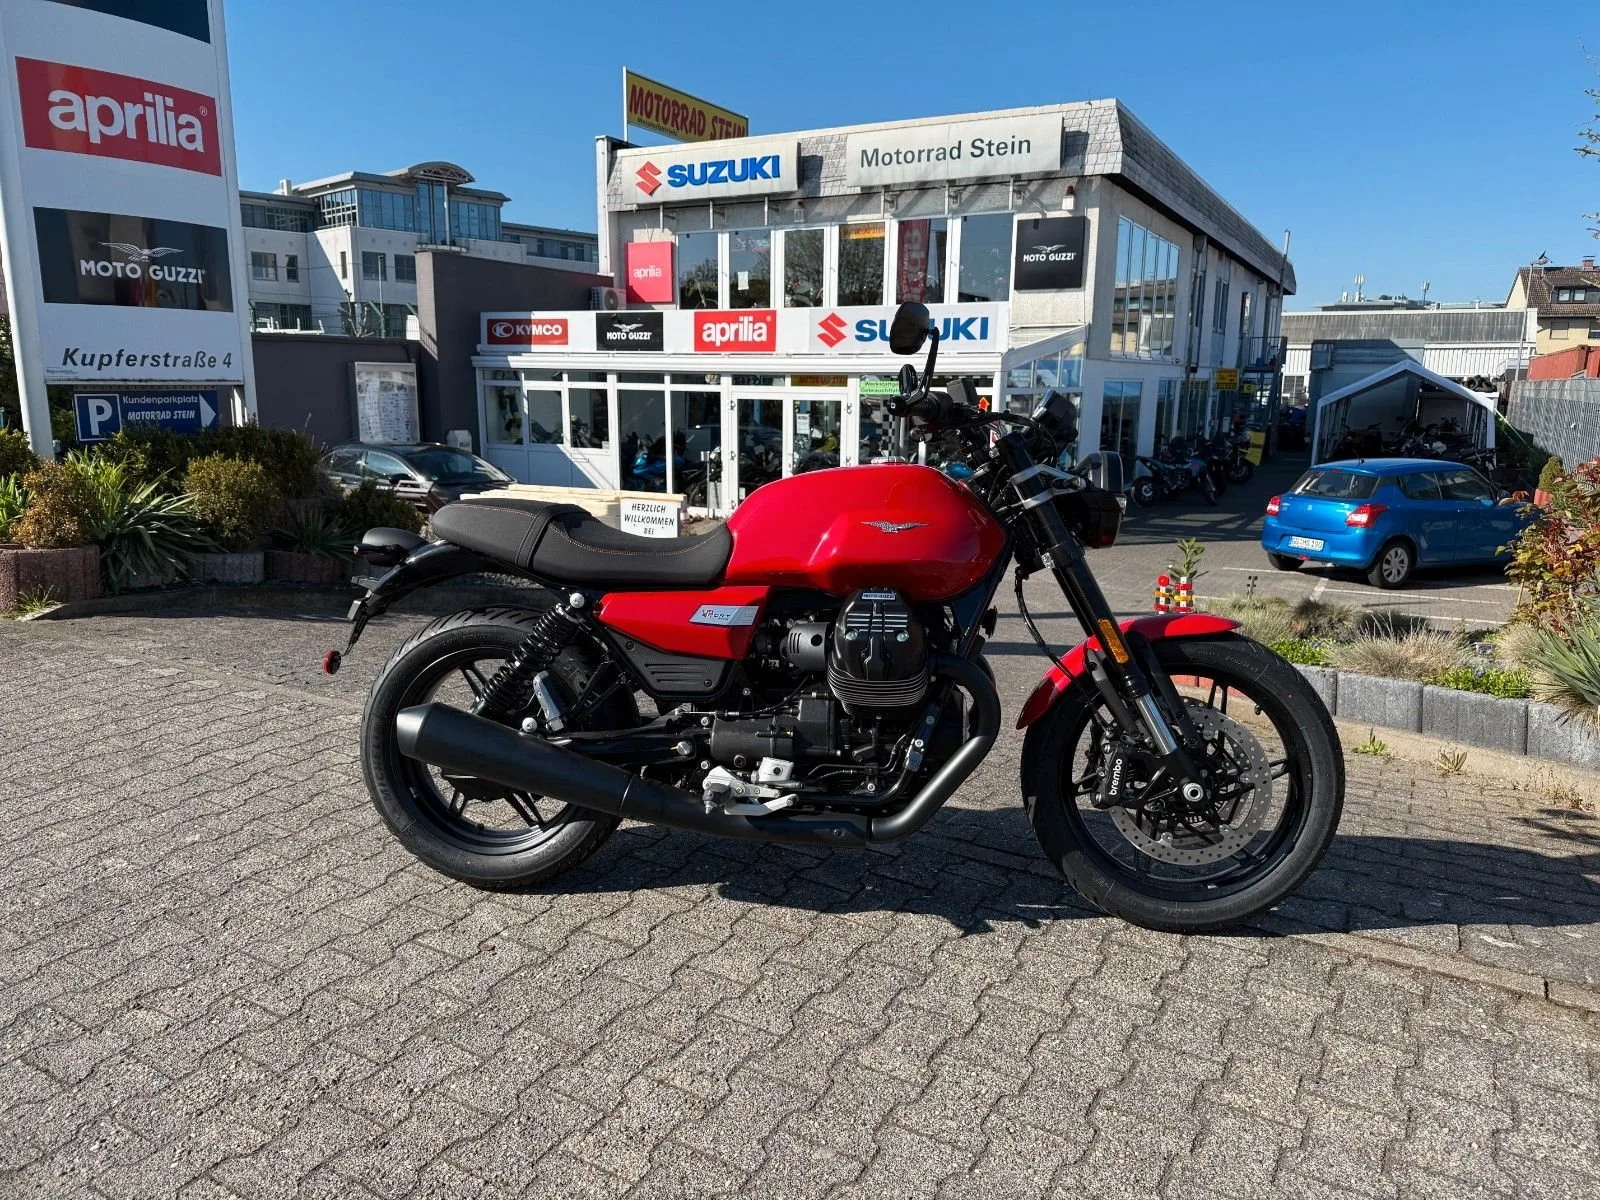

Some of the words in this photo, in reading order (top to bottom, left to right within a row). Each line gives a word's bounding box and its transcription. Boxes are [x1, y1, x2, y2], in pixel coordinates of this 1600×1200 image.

[48, 90, 204, 152] aprilia
[629, 84, 706, 137] MOTORRAD
[861, 140, 962, 168] Motorrad
[970, 135, 1031, 158] Stein
[667, 155, 780, 188] SUZUKI
[1023, 254, 1046, 262] MOTO
[1048, 252, 1075, 261] GUZZI
[80, 259, 141, 279] MOTO
[149, 265, 203, 284] GUZZI
[633, 265, 662, 279] aprilia
[516, 324, 562, 336] KYMCO
[606, 331, 627, 340] MOTO
[628, 331, 651, 340] GUZZI
[702, 315, 768, 346] aprilia
[62, 347, 217, 370] Kupferstraße
[222, 352, 232, 368] 4
[122, 395, 199, 405] Kundenparkplatz
[87, 399, 113, 436] P
[127, 410, 171, 421] MOTORRAD
[173, 410, 195, 419] STEIN
[624, 513, 674, 526] WILLKOMMEN
[631, 503, 667, 513] HERZLICH
[1108, 758, 1123, 796] brembo
